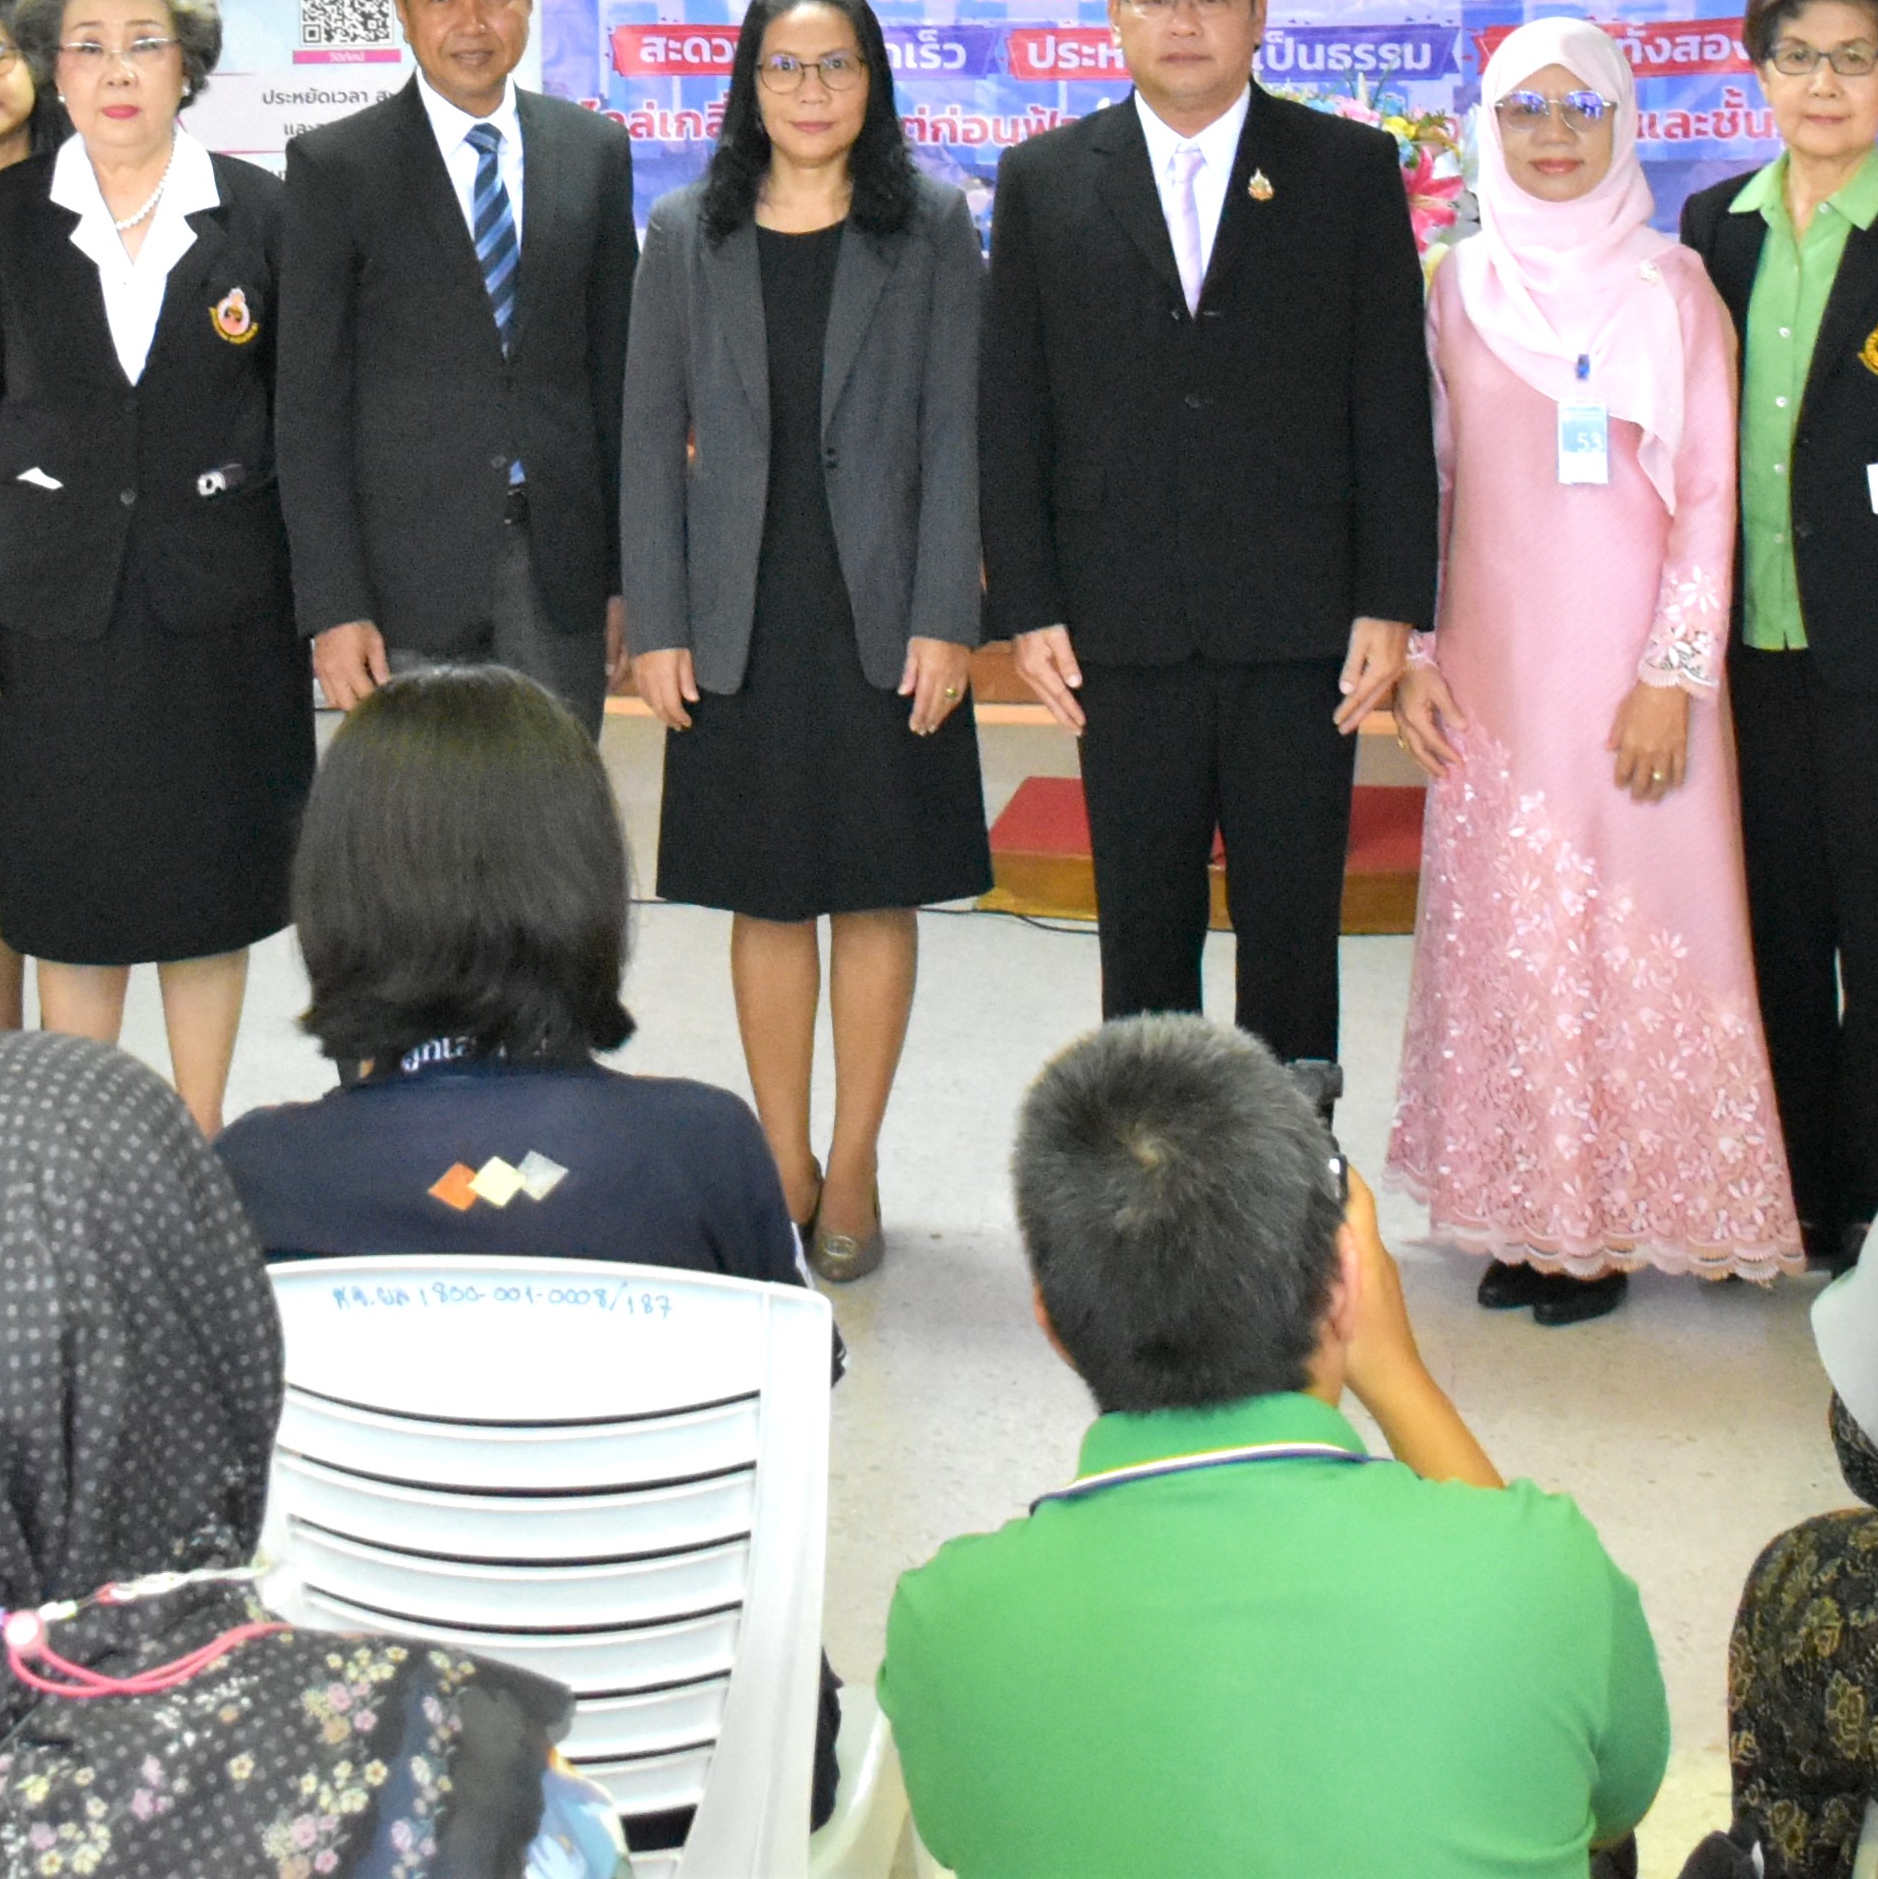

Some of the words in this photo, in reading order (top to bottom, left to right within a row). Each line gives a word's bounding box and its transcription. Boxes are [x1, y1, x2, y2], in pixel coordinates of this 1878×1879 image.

[262, 88, 369, 105] ประหยัดเวลา
